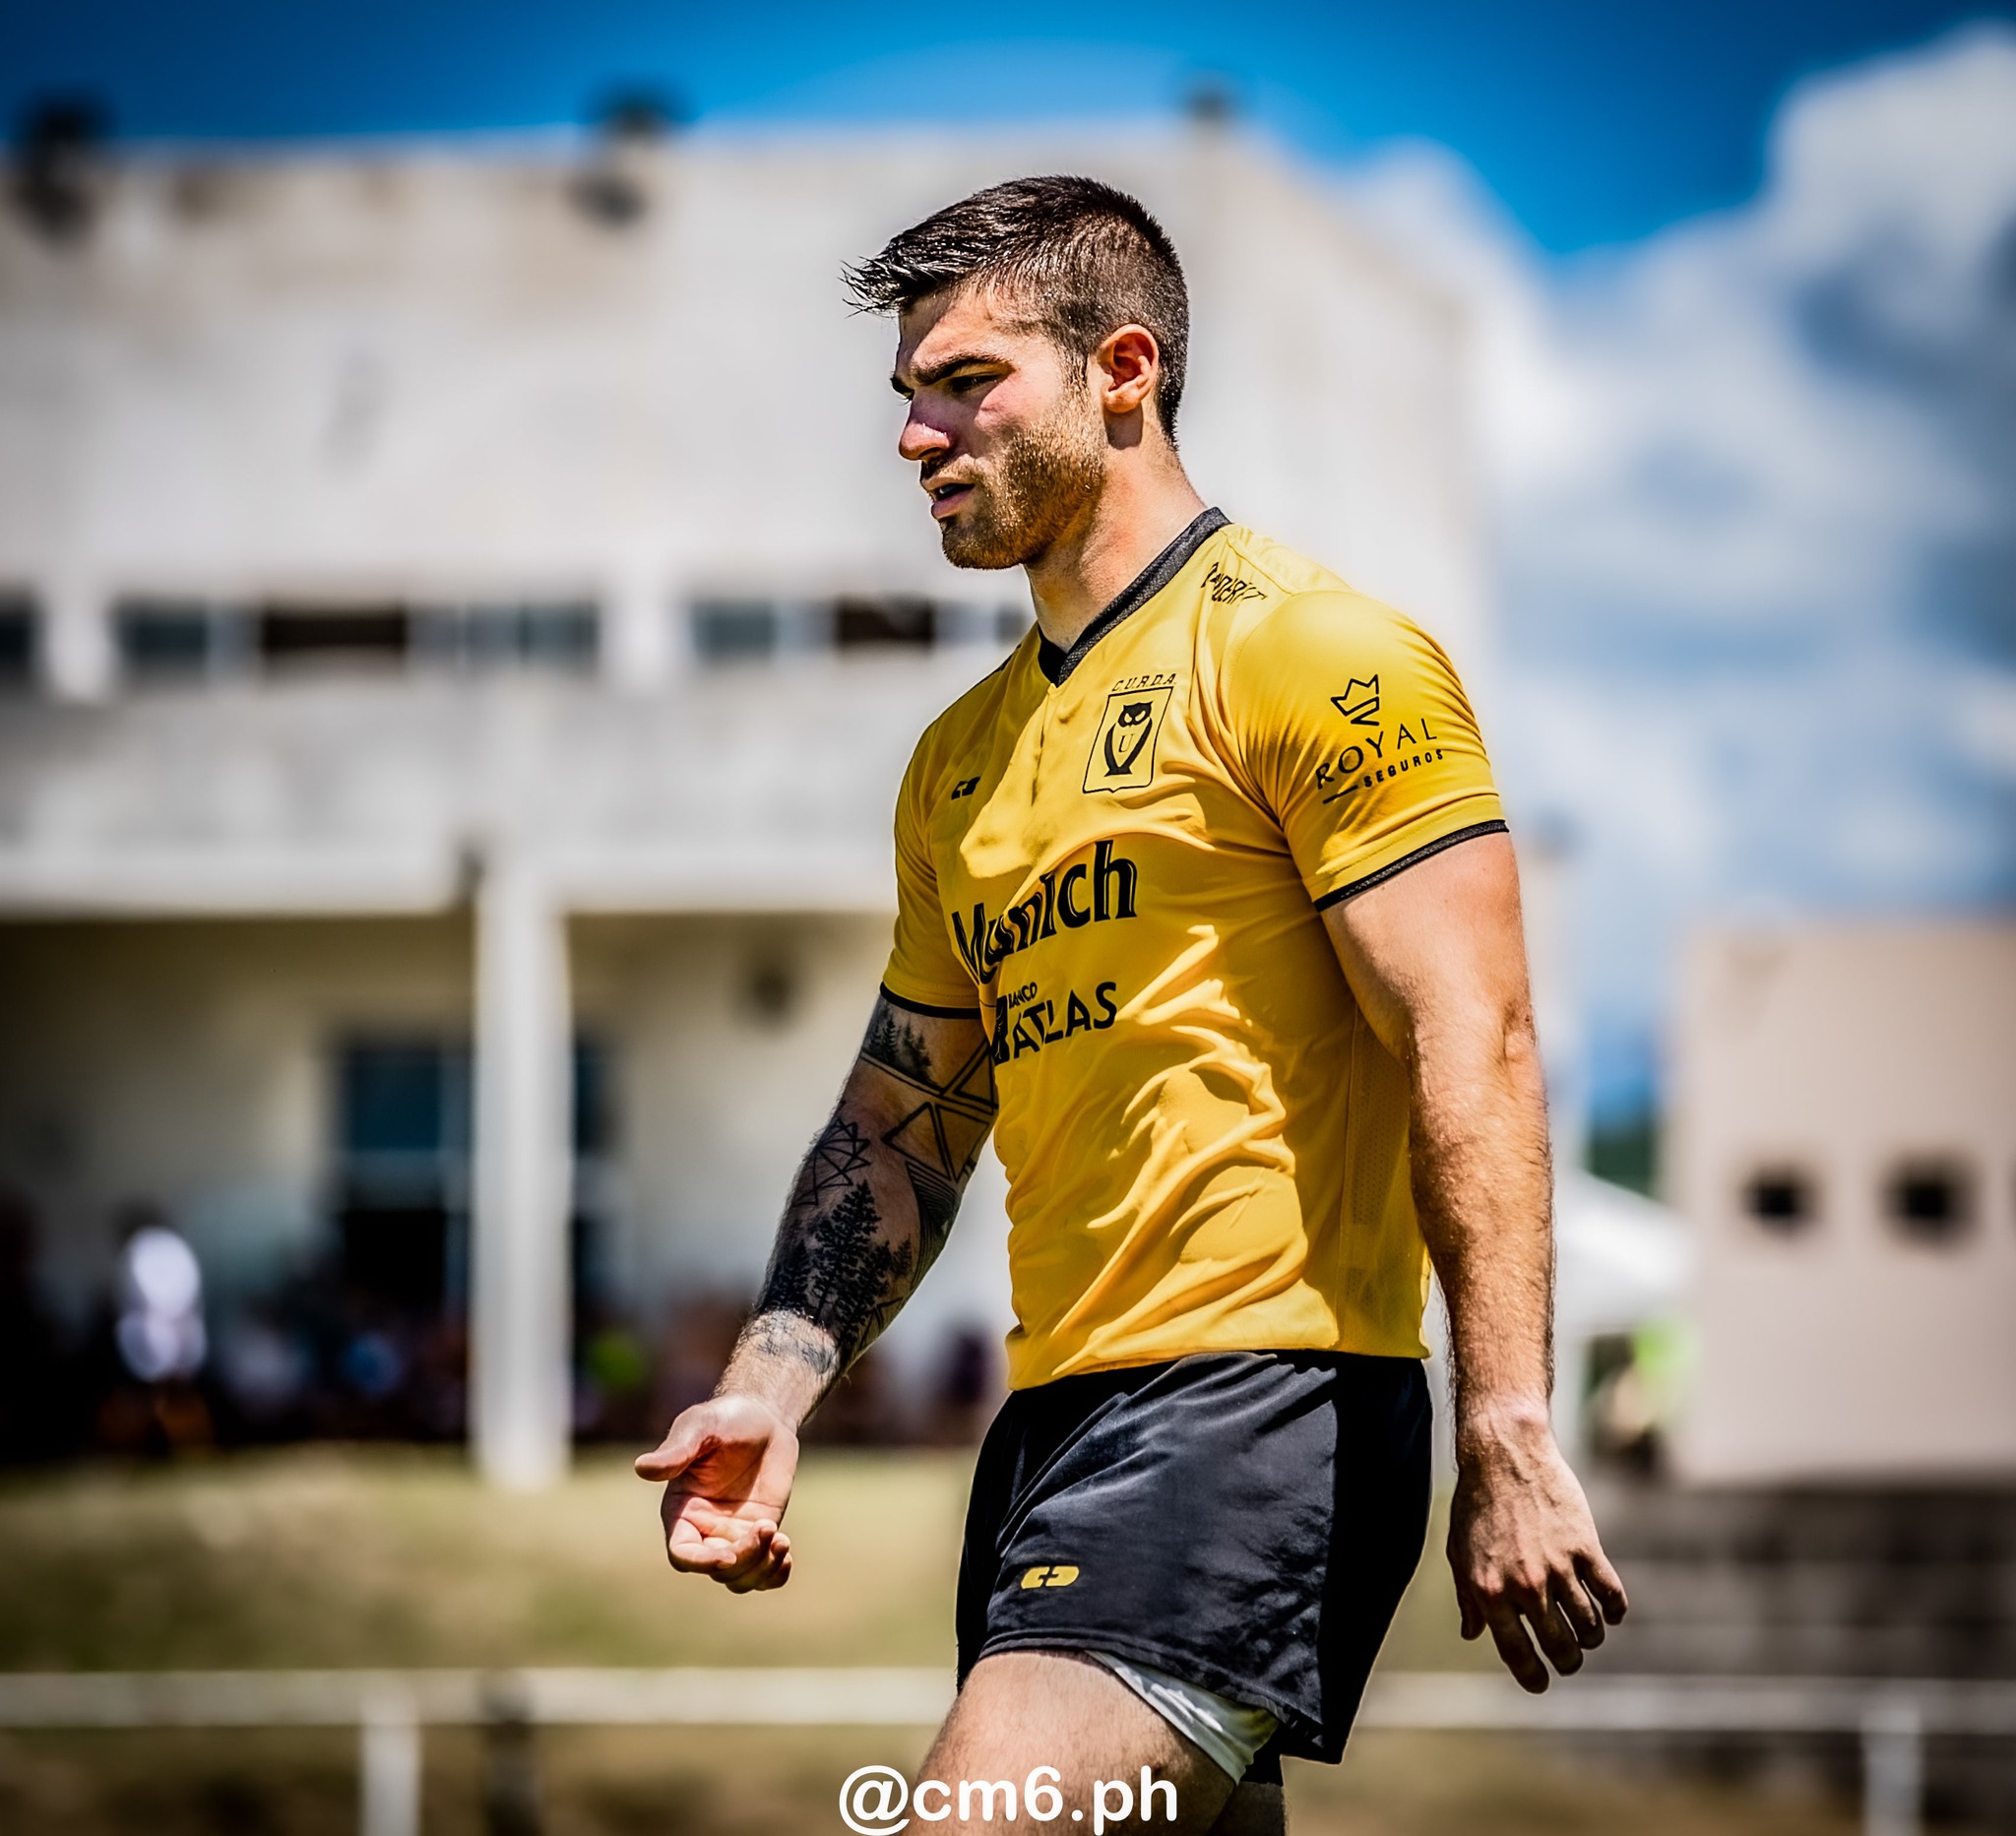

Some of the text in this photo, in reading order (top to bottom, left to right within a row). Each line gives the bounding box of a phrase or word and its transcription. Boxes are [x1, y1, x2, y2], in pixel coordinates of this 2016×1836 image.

[1314, 718, 1437, 790] ROYAL
[1362, 748, 1444, 788] SEGUROS
[951, 840, 1138, 985] Munich
[1008, 981, 1038, 1009] BANCO
